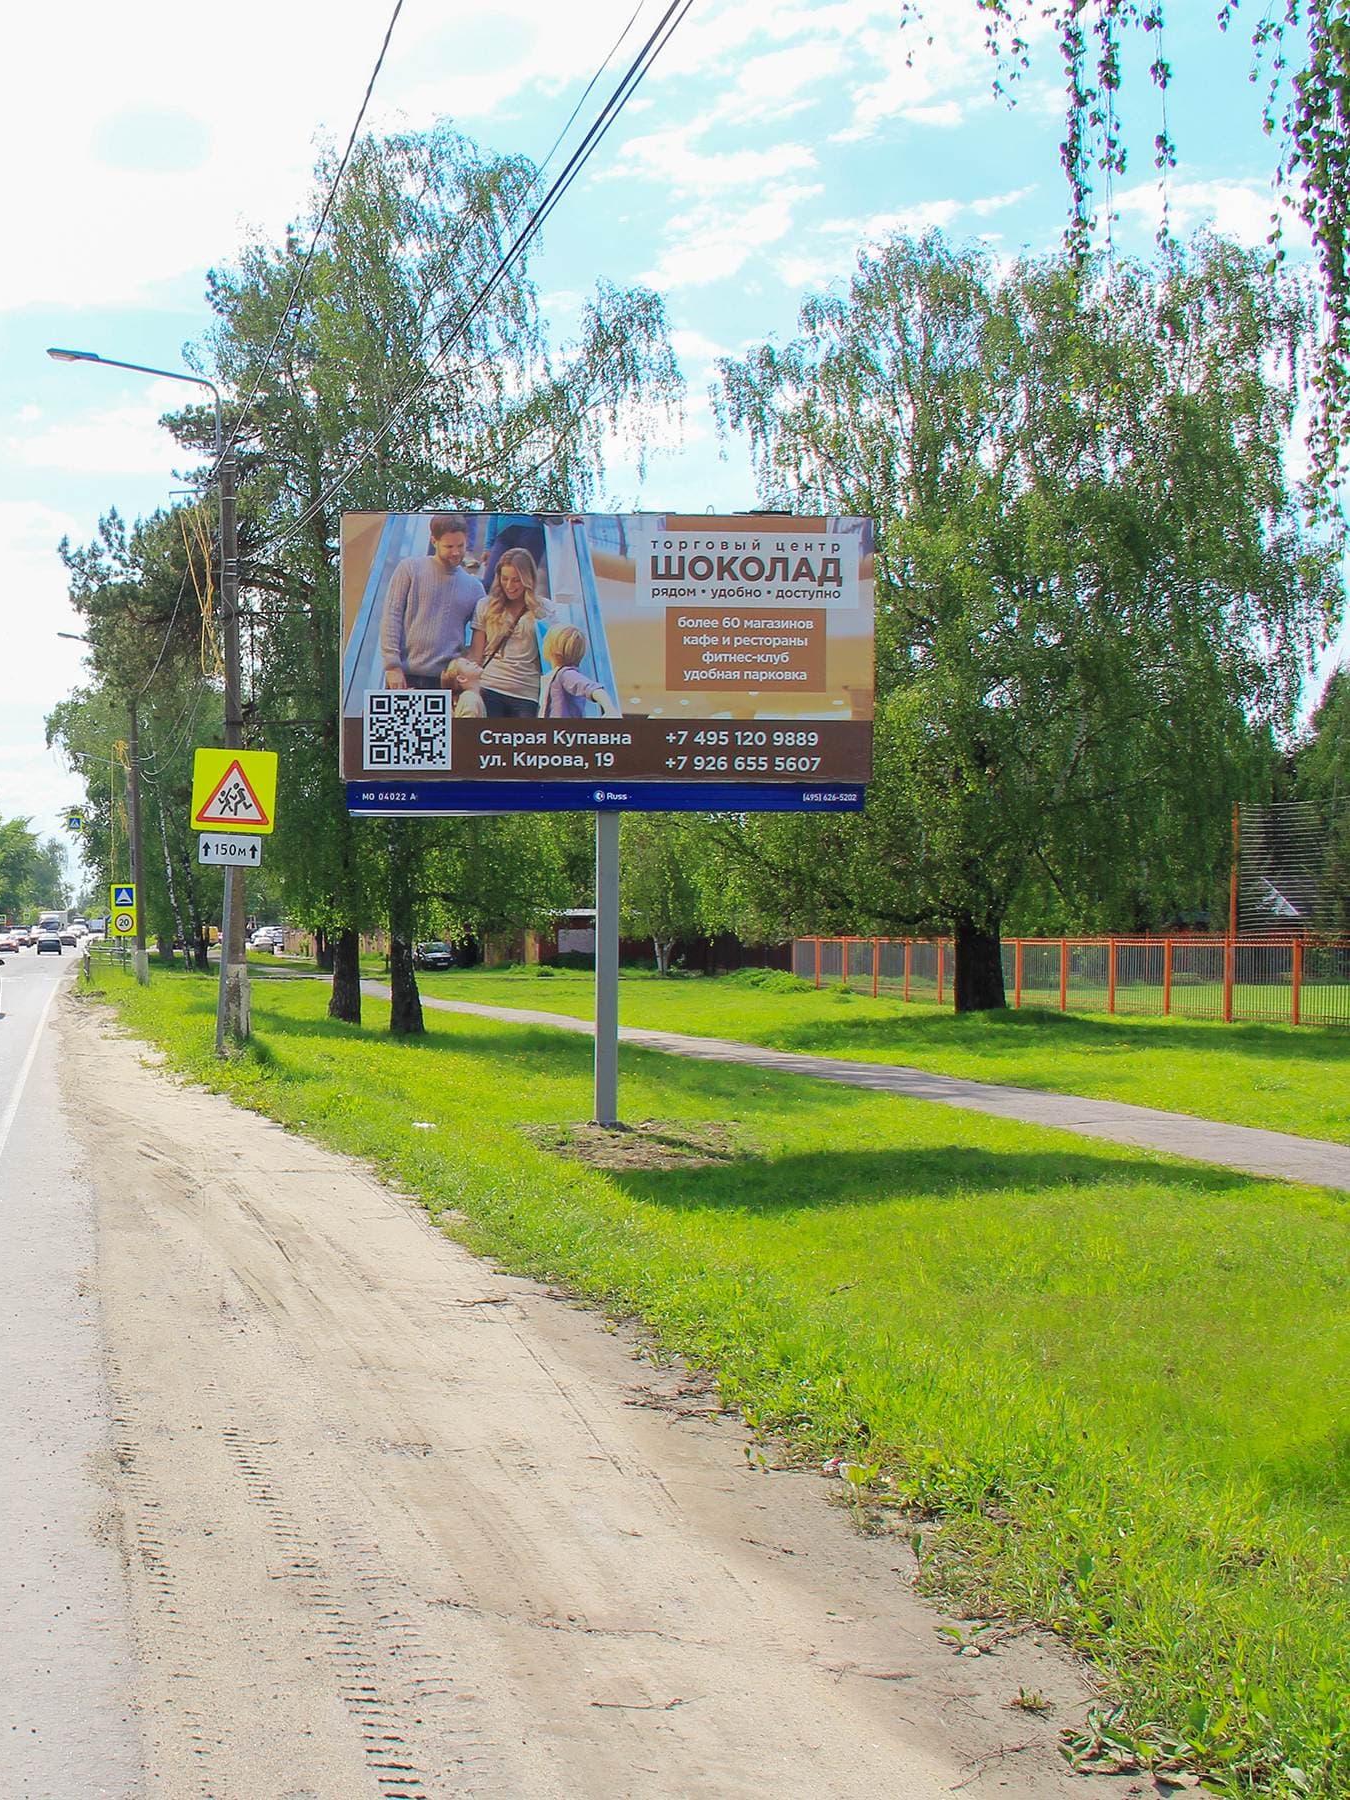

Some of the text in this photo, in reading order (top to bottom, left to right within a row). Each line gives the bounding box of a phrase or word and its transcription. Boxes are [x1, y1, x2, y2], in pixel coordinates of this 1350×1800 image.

[651, 539, 841, 553] торговый центр
[651, 555, 843, 587] ШОКОЛАД
[651, 587, 841, 600] рядом удобно доступно
[677, 617, 815, 630] более 60 магазинов
[683, 634, 809, 647] кафе и рестораны
[702, 651, 790, 665] фитнес-клуб
[683, 668, 808, 682] удобная парковка
[479, 730, 632, 747] Старая Купавна
[666, 731, 819, 746] +7 495 120 9889
[479, 752, 614, 770] ул. Кирова, 19
[666, 756, 822, 771] +7 926 655 5607
[378, 792, 406, 801] 04022
[606, 792, 628, 801] Russ
[802, 792, 857, 802] (495) 626-5202
[119, 918, 129, 927] 20
